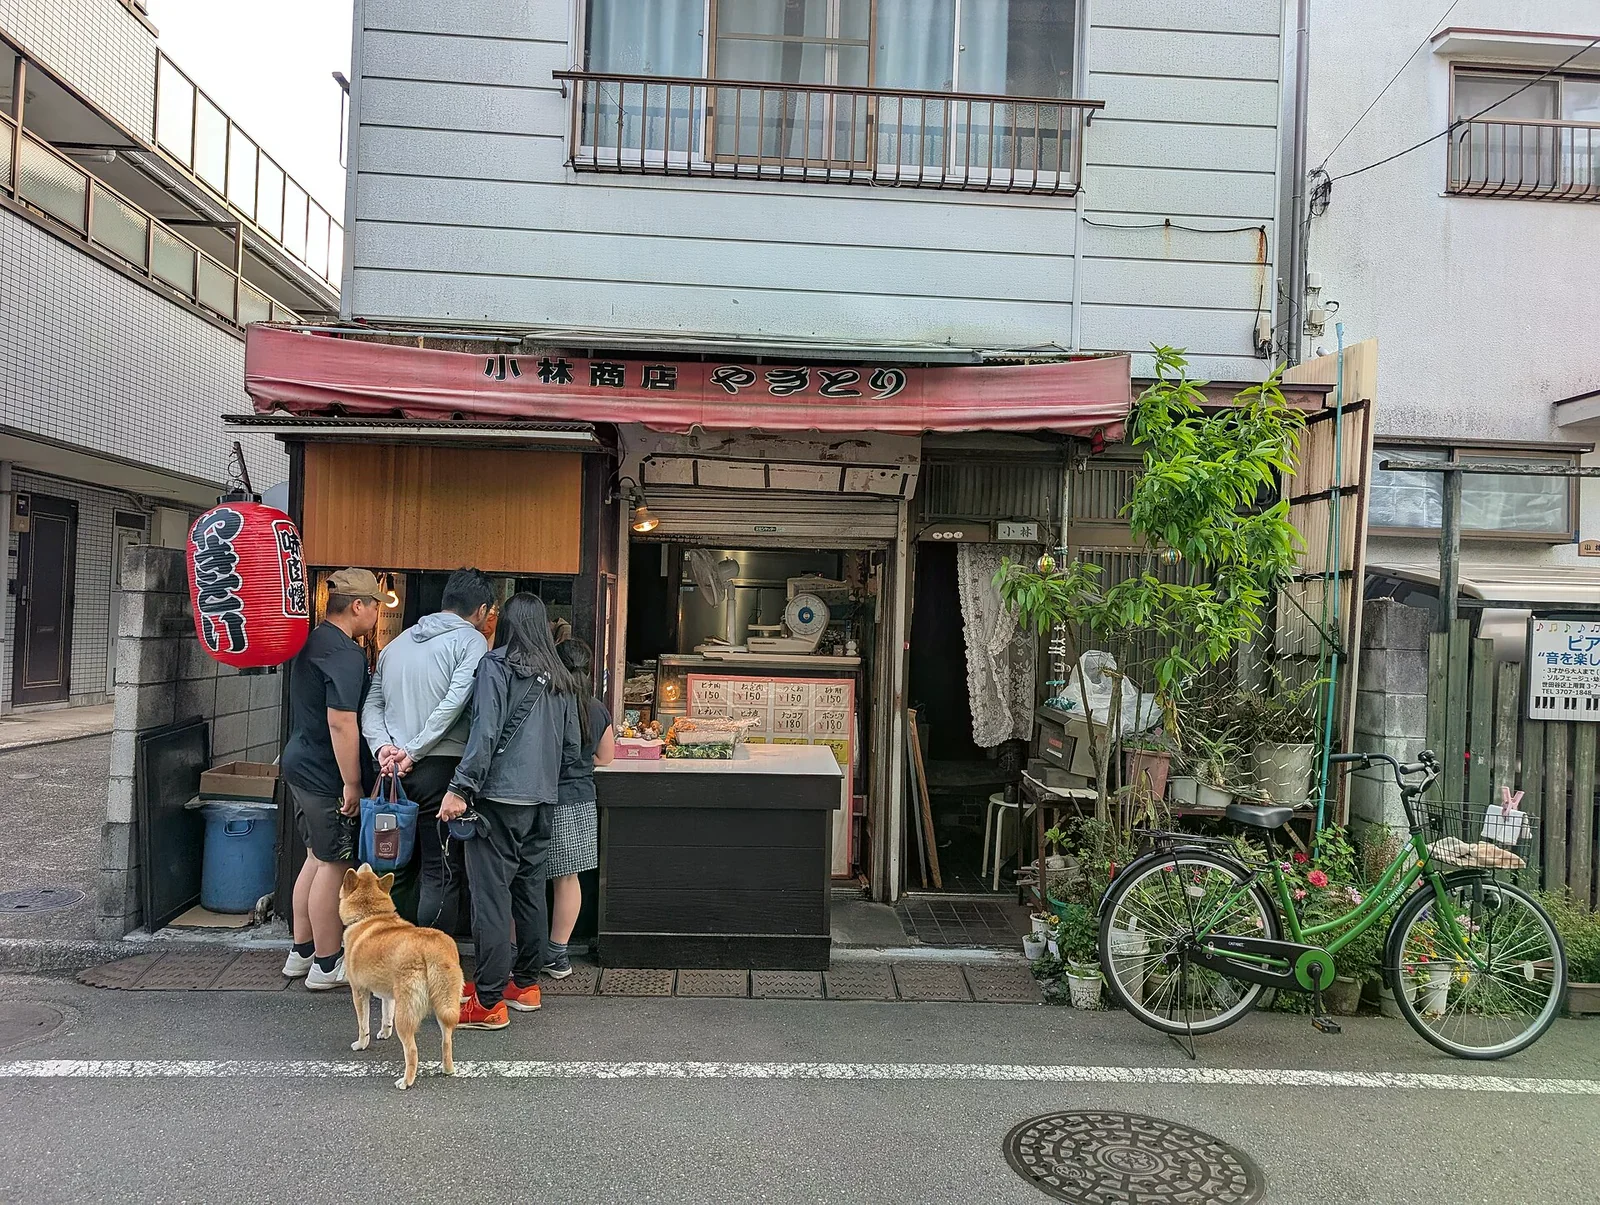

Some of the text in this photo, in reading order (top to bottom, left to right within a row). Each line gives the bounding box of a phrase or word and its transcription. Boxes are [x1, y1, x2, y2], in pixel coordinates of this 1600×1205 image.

[483, 354, 907, 400] 小林商店 やきとり
[1003, 526, 1033, 538] 小林
[191, 507, 249, 654] やきとり
